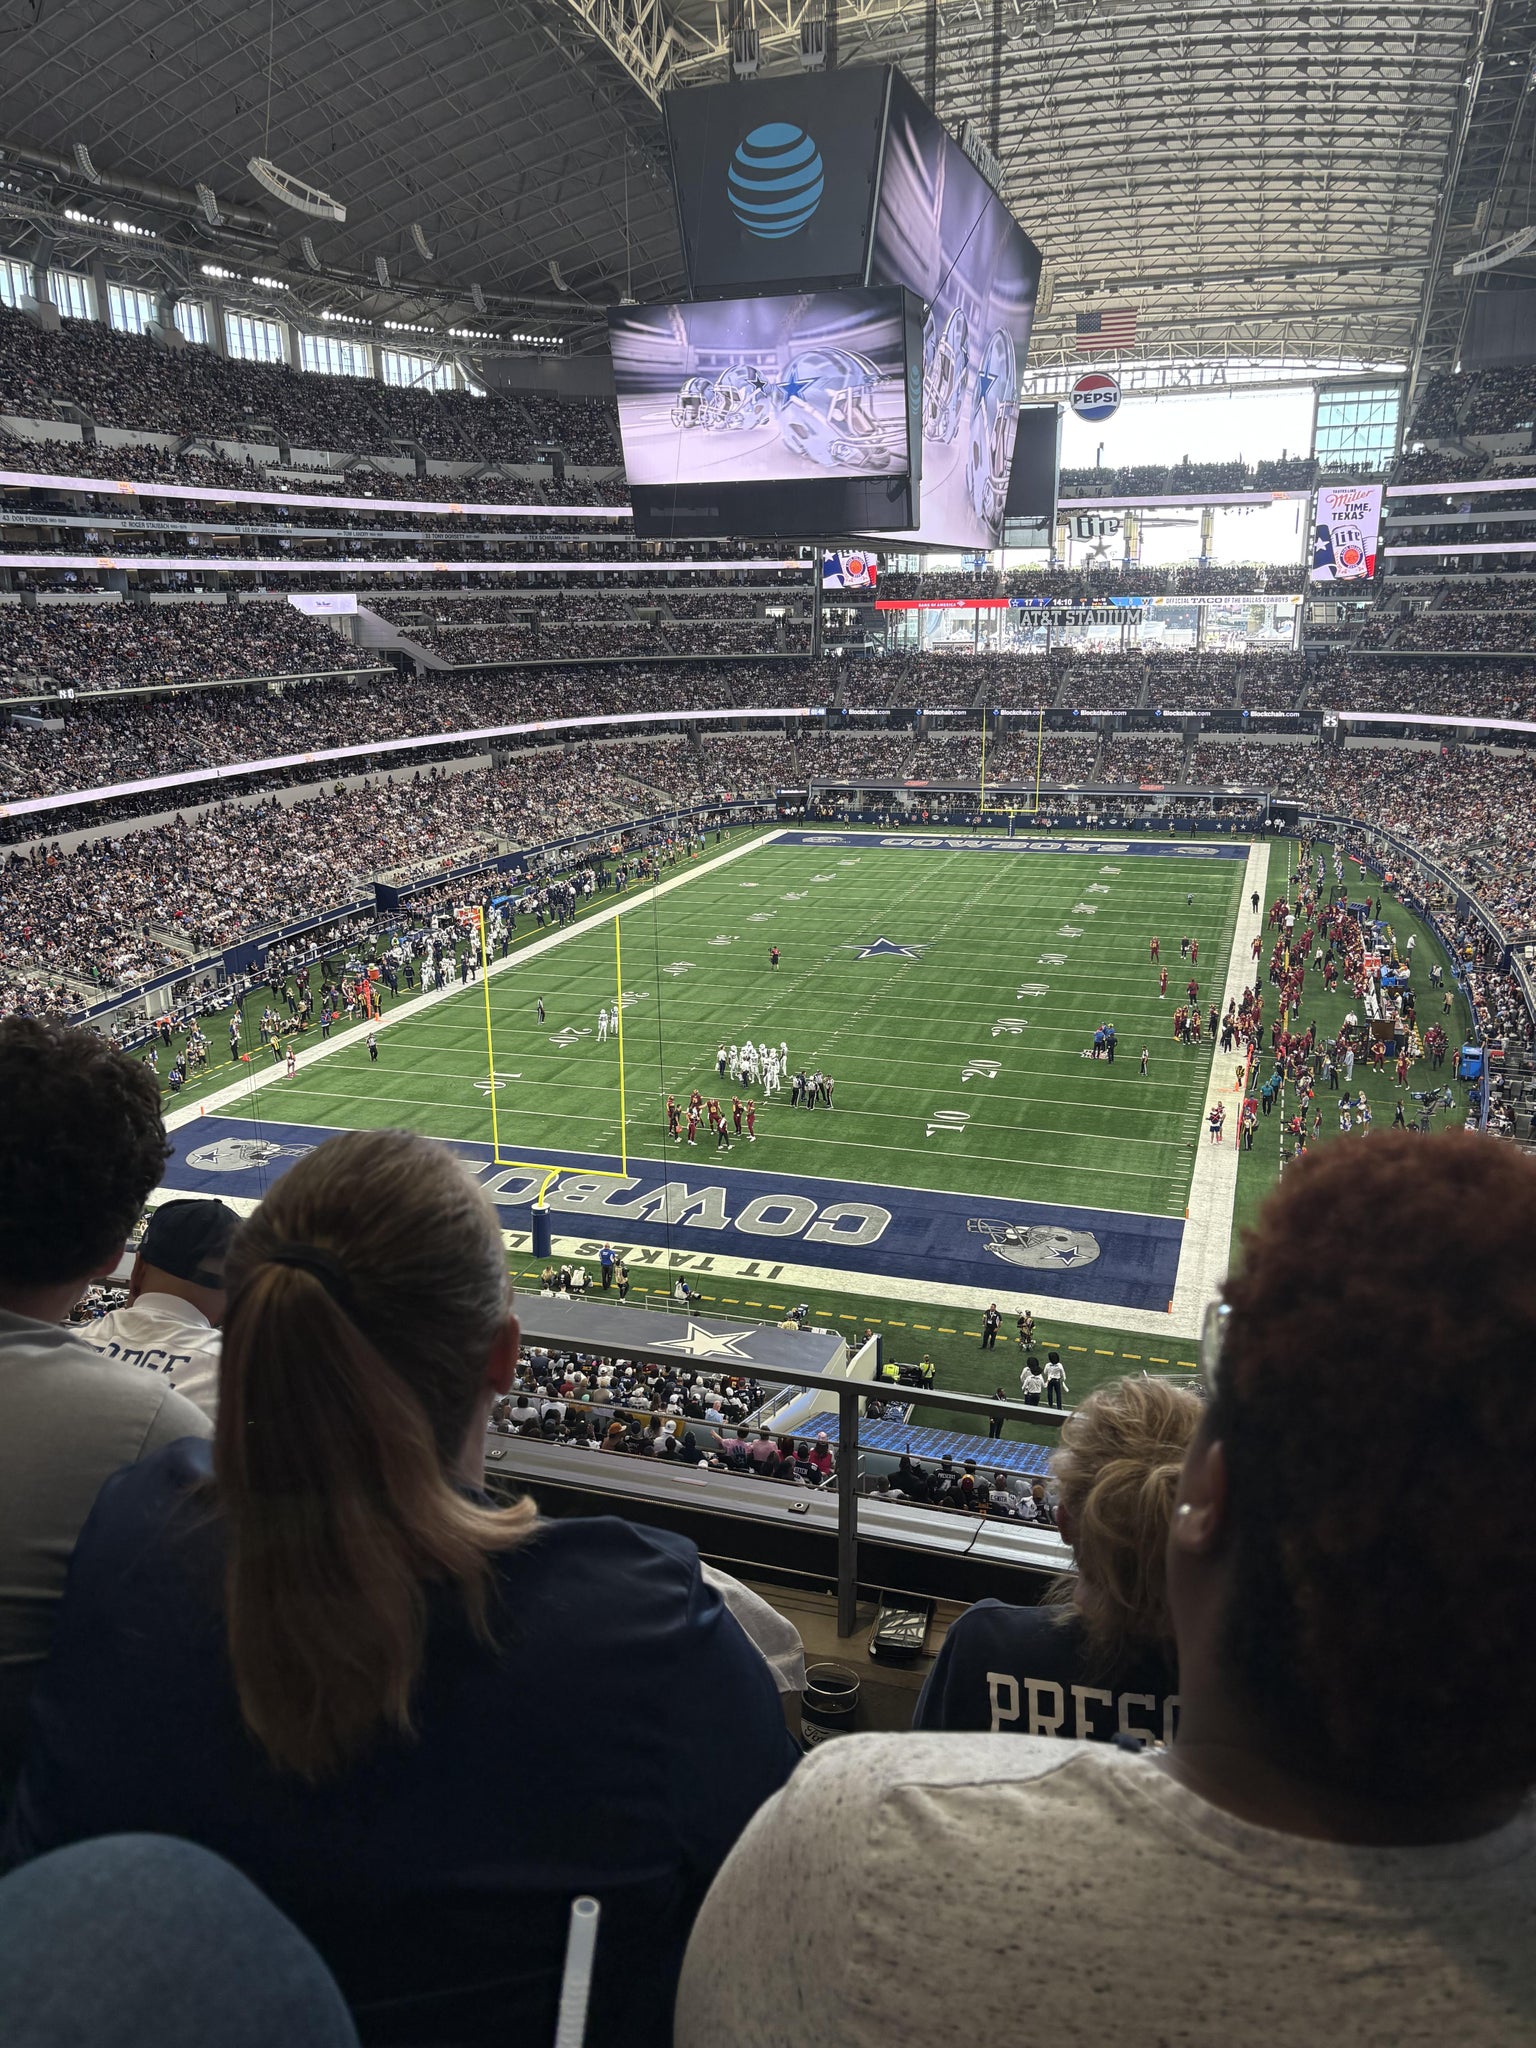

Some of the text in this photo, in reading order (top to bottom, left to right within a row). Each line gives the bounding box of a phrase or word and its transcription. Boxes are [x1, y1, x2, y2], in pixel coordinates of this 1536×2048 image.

[1074, 392, 1117, 404] PEPSI
[1326, 489, 1375, 509] Miller
[1332, 511, 1364, 520] TEXAS
[1345, 503, 1372, 512] TIME,
[1067, 515, 1120, 542] Lite
[1335, 530, 1360, 547] Lite
[1020, 608, 1142, 626] AT&T STADIUM
[1250, 710, 1300, 718] Blockchain.com
[879, 838, 1130, 852] COWBOYS
[1018, 983, 1050, 997] 40
[991, 1018, 1029, 1034] 30
[549, 1027, 593, 1043] 20
[961, 1059, 1002, 1079] 20
[473, 1071, 523, 1089] 10
[926, 1110, 971, 1133] 10
[575, 1242, 785, 1279] IT TAKES
